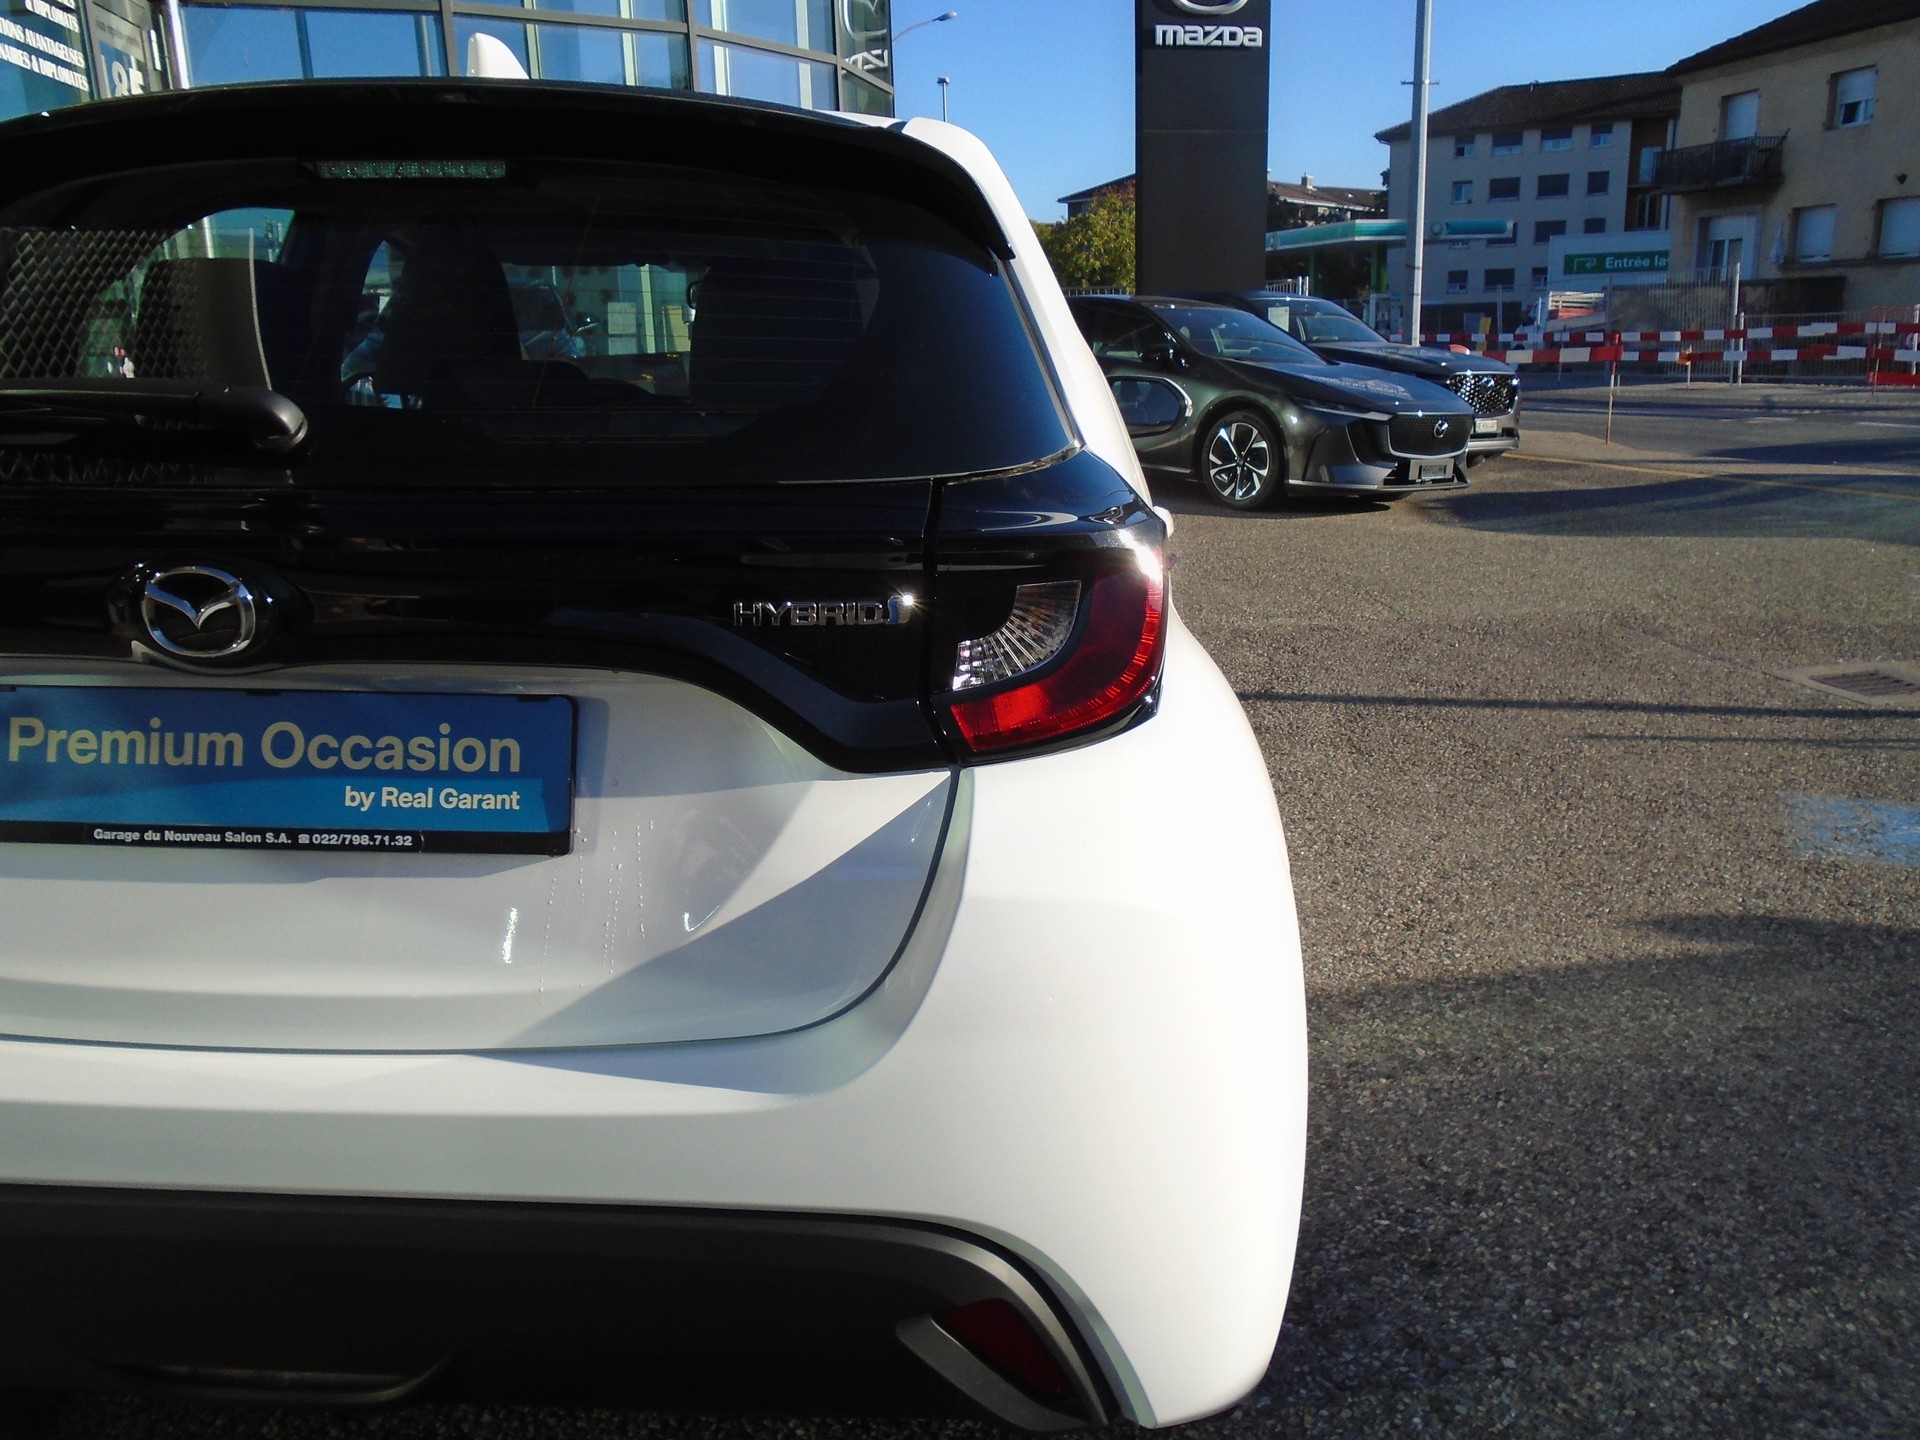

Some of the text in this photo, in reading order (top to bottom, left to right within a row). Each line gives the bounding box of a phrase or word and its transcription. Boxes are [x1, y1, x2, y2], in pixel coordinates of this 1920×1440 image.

[1605, 256, 1650, 269] Entrée
[734, 601, 884, 626] HYBRID
[8, 716, 521, 772] Premium Occasion
[344, 785, 520, 811] by Real Garant
[93, 828, 413, 846] Garage du Nouveau Salon S.A. 022/798.71.32
